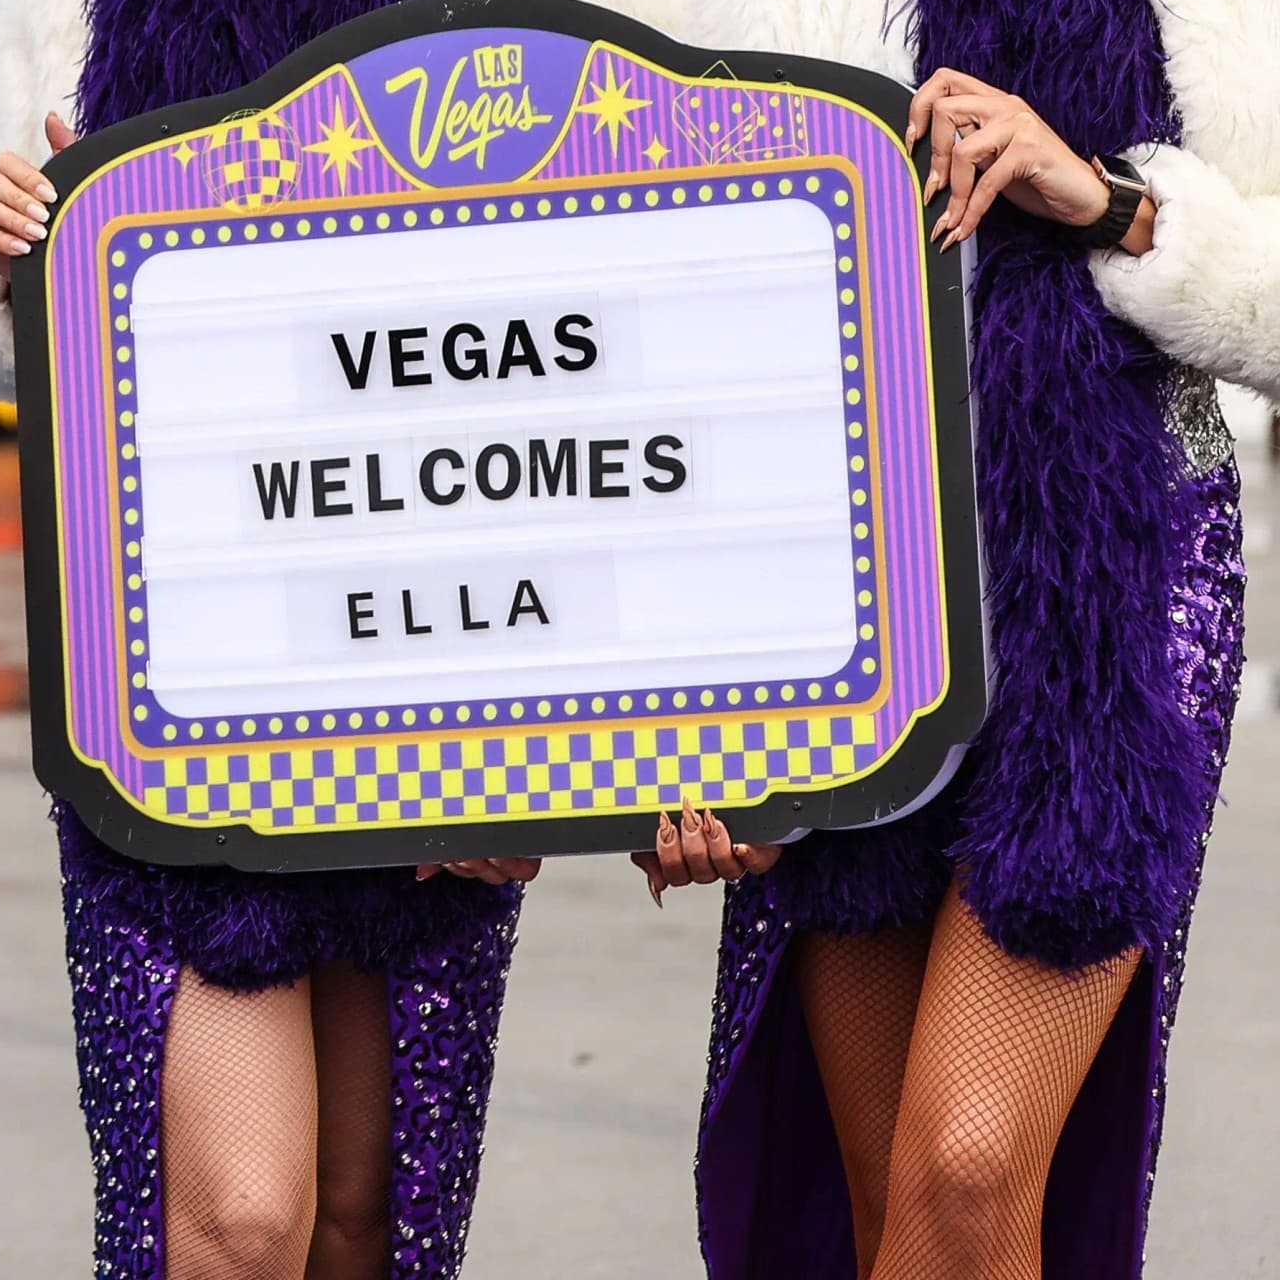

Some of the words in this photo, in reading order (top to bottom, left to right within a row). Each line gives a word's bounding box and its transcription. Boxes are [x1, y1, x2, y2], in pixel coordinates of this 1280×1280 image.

[476, 47, 520, 84] LAS
[385, 56, 553, 170] Vegas
[330, 313, 599, 390] VEGAS
[252, 434, 688, 520] WELCOMES
[347, 579, 551, 639] ELLA
